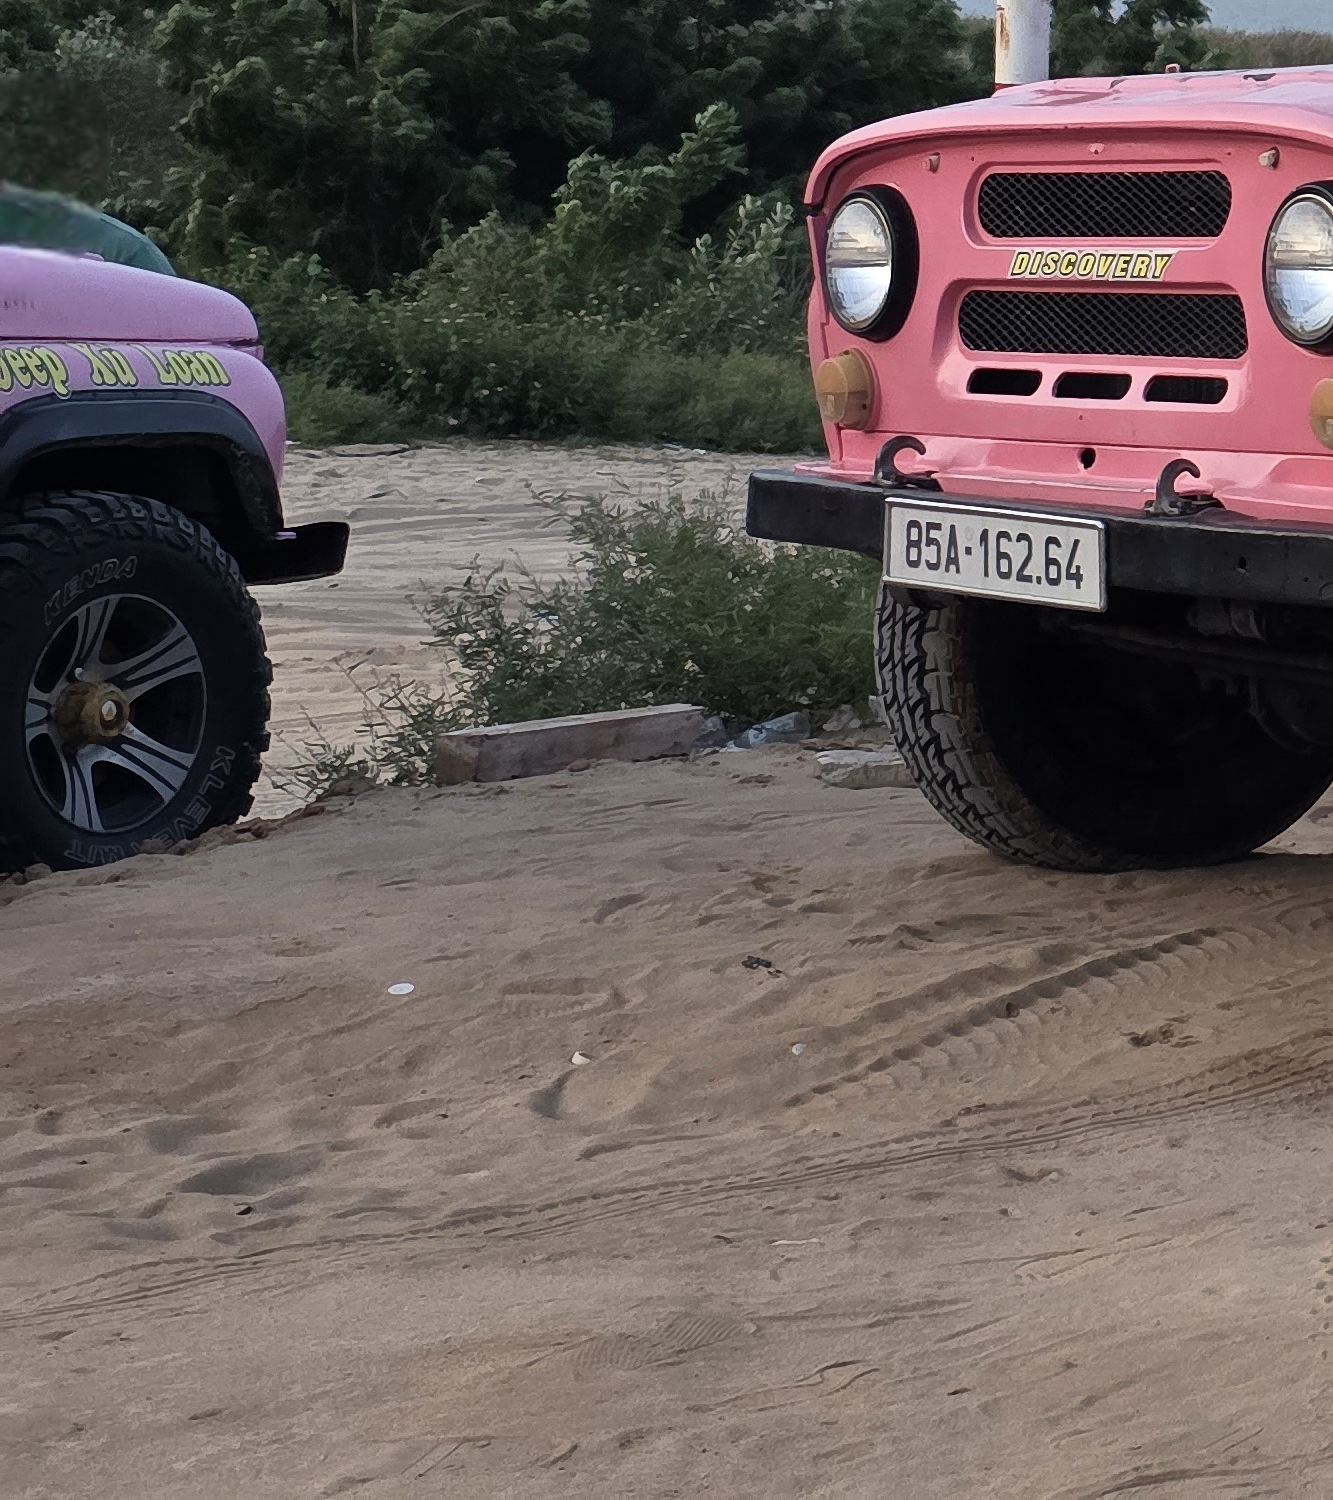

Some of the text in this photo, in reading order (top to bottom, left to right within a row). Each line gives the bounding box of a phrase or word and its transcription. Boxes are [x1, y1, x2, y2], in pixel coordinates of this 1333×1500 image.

[1010, 251, 1174, 279] DISCOVERY
[127, 342, 232, 387] Loan
[905, 519, 1084, 591] 85A-162.64
[43, 555, 138, 627] KENDA
